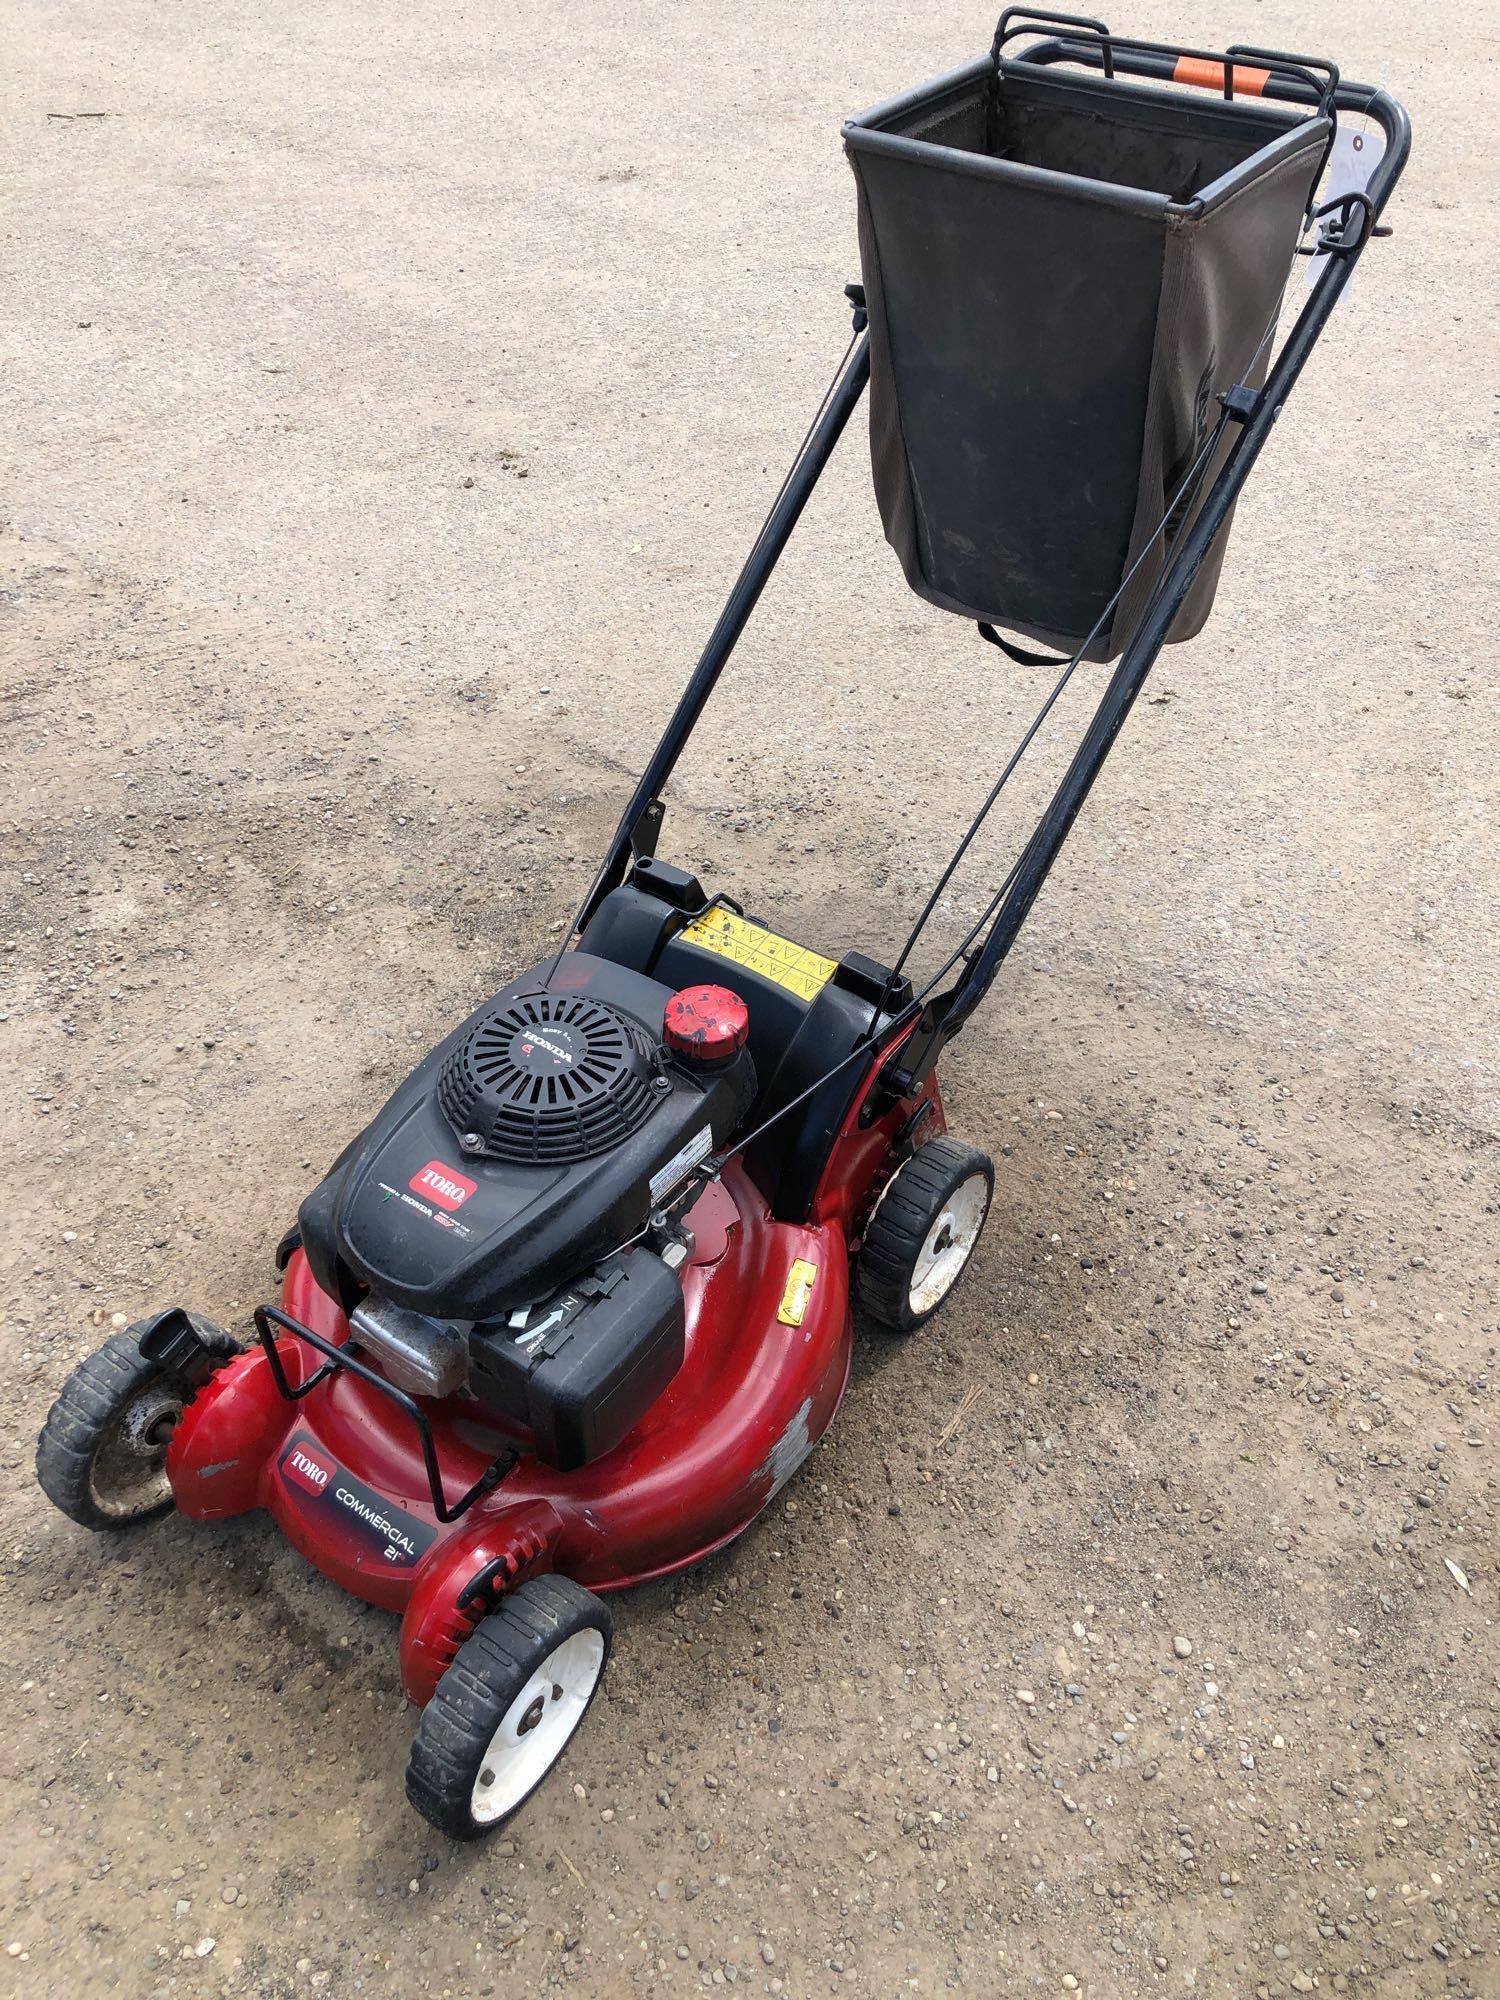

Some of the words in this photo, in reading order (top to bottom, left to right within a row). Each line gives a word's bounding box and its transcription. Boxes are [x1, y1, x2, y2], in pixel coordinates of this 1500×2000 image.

[522, 1030, 572, 1063] HONDA
[420, 1168, 466, 1201] TORO
[400, 1193, 433, 1217] HONDA
[290, 1450, 328, 1486] TORO
[335, 1487, 415, 1555] COMMERCIAL
